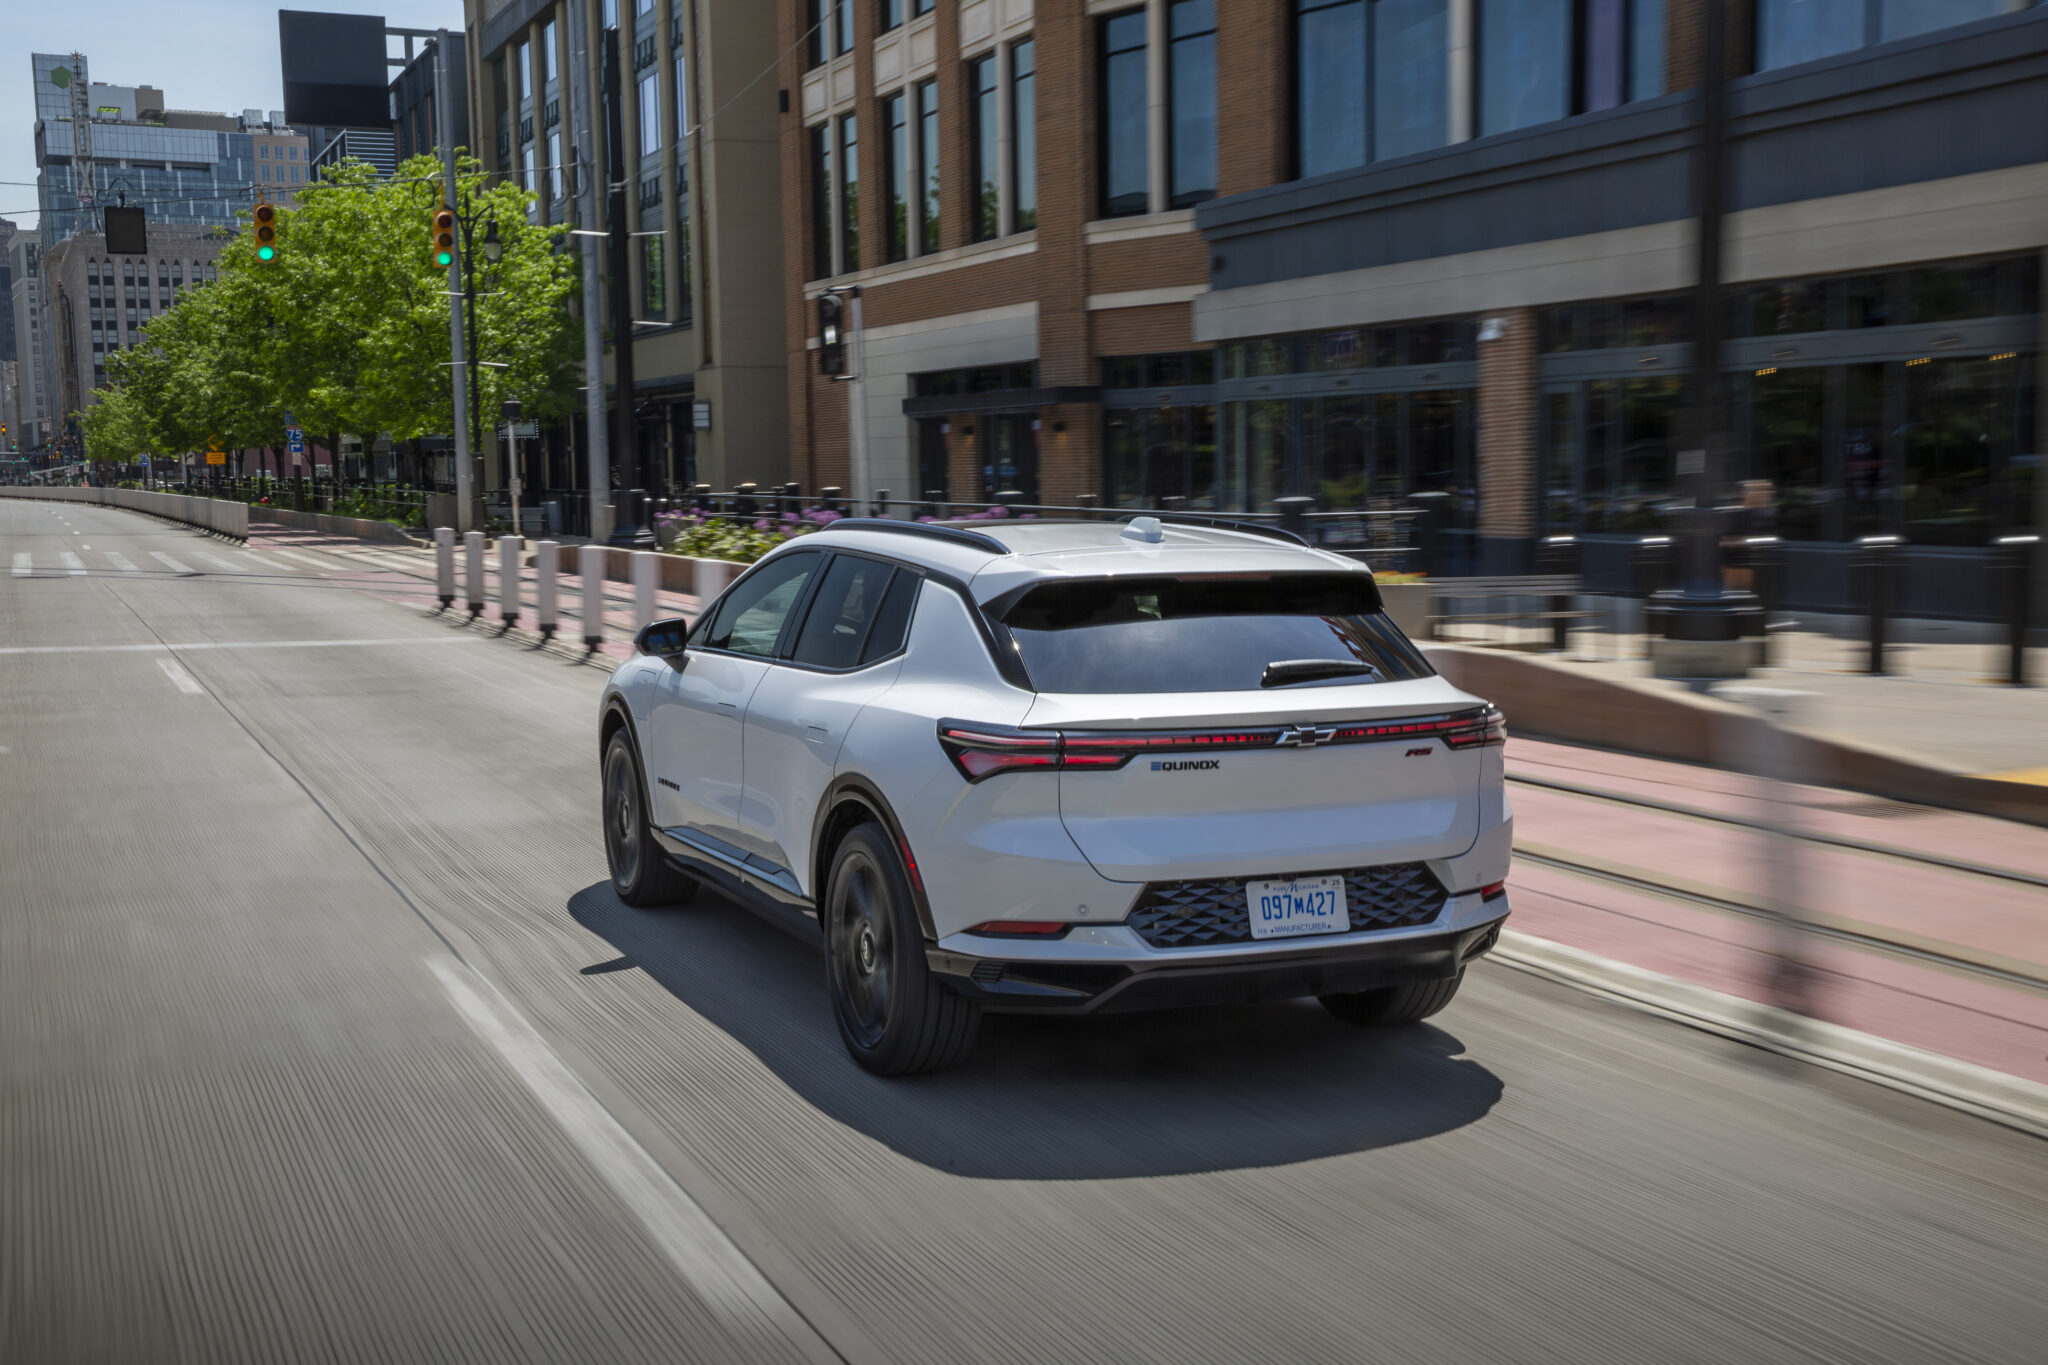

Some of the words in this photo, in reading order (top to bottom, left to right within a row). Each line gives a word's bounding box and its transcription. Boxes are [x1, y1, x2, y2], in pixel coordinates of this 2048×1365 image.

[288, 429, 303, 439] 75
[1405, 747, 1433, 757] RS
[1151, 760, 1220, 771] EQUINOX
[1261, 891, 1335, 920] 097M427
[1275, 922, 1326, 933] MANUFACTURER
